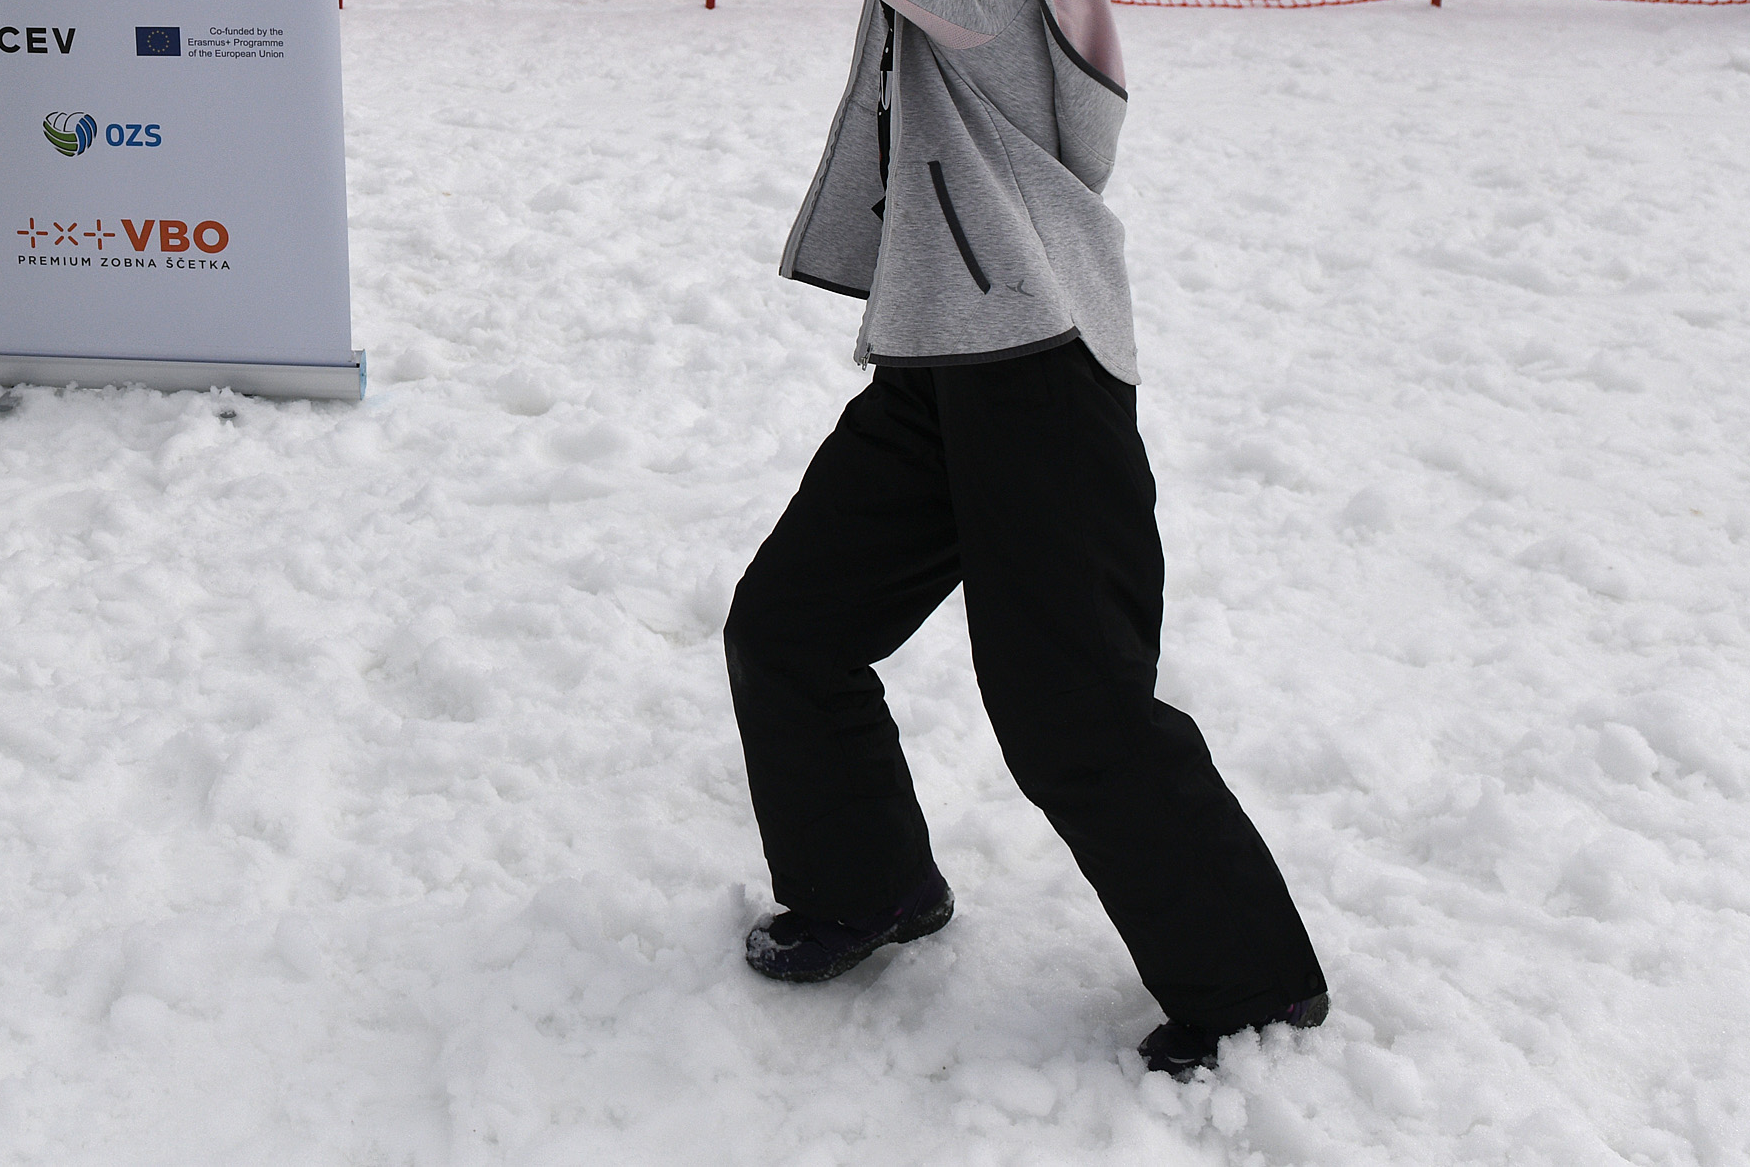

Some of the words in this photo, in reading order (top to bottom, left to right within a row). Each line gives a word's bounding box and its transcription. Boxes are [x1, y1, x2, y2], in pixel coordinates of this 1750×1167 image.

[209, 27, 255, 36] Co-funded
[256, 27, 267, 38] by
[269, 28, 284, 36] the
[187, 38, 231, 47] Erasmus+
[233, 38, 284, 49] Programme
[188, 49, 198, 57] of
[199, 49, 213, 57] the
[214, 50, 257, 60] European
[258, 50, 285, 59] Union
[105, 123, 162, 148] OZS
[120, 219, 230, 255] VBO
[17, 255, 93, 268] PREMIUM
[100, 257, 158, 269] ZOBNA
[165, 256, 231, 271] ŠČETKA
